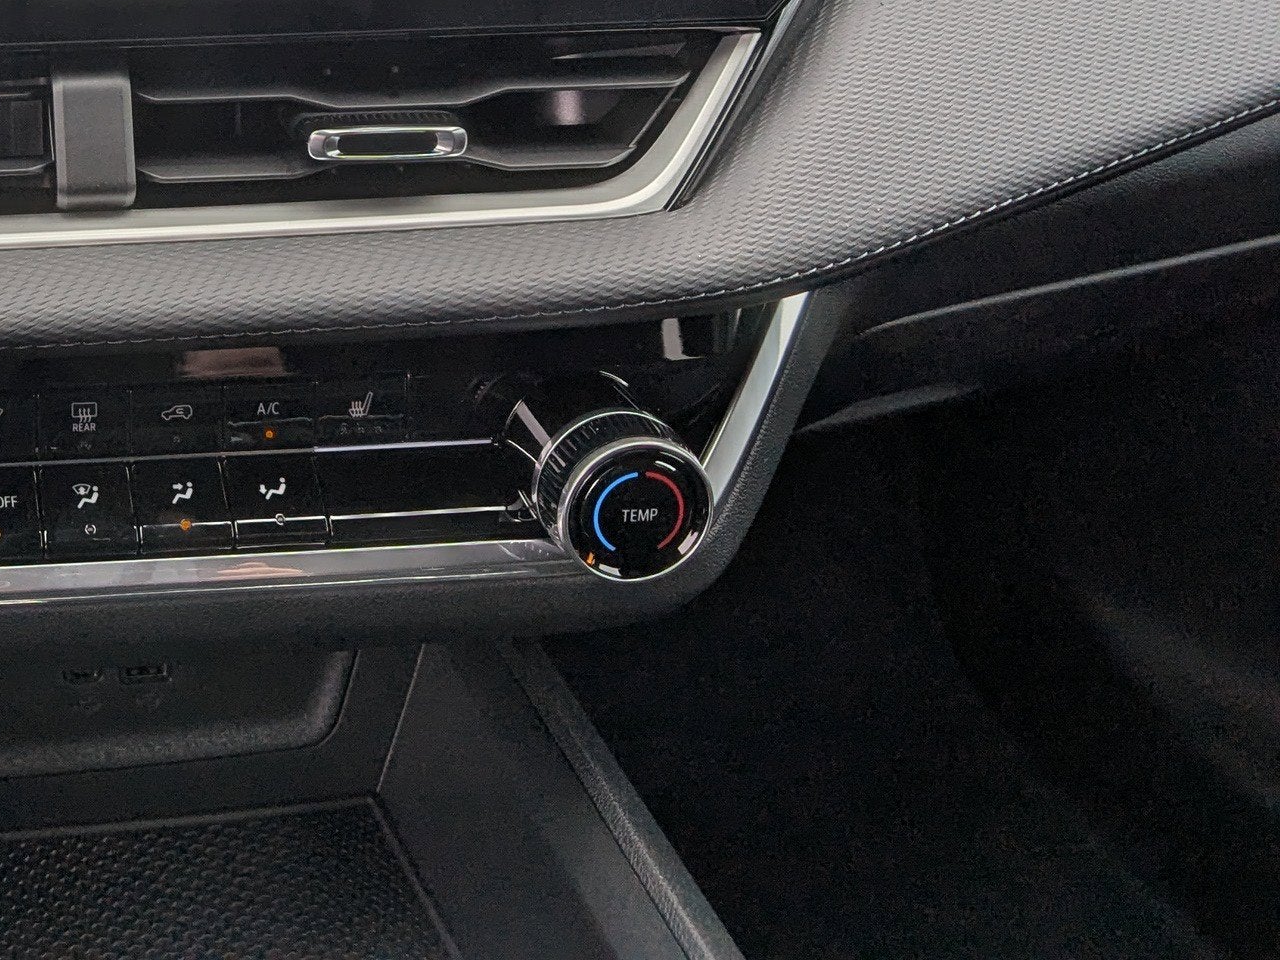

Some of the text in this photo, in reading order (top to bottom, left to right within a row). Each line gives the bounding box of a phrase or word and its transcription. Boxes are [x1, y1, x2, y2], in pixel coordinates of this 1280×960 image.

[257, 402, 280, 416] A/C
[72, 422, 96, 432] REAR
[621, 508, 658, 523] TEMP
